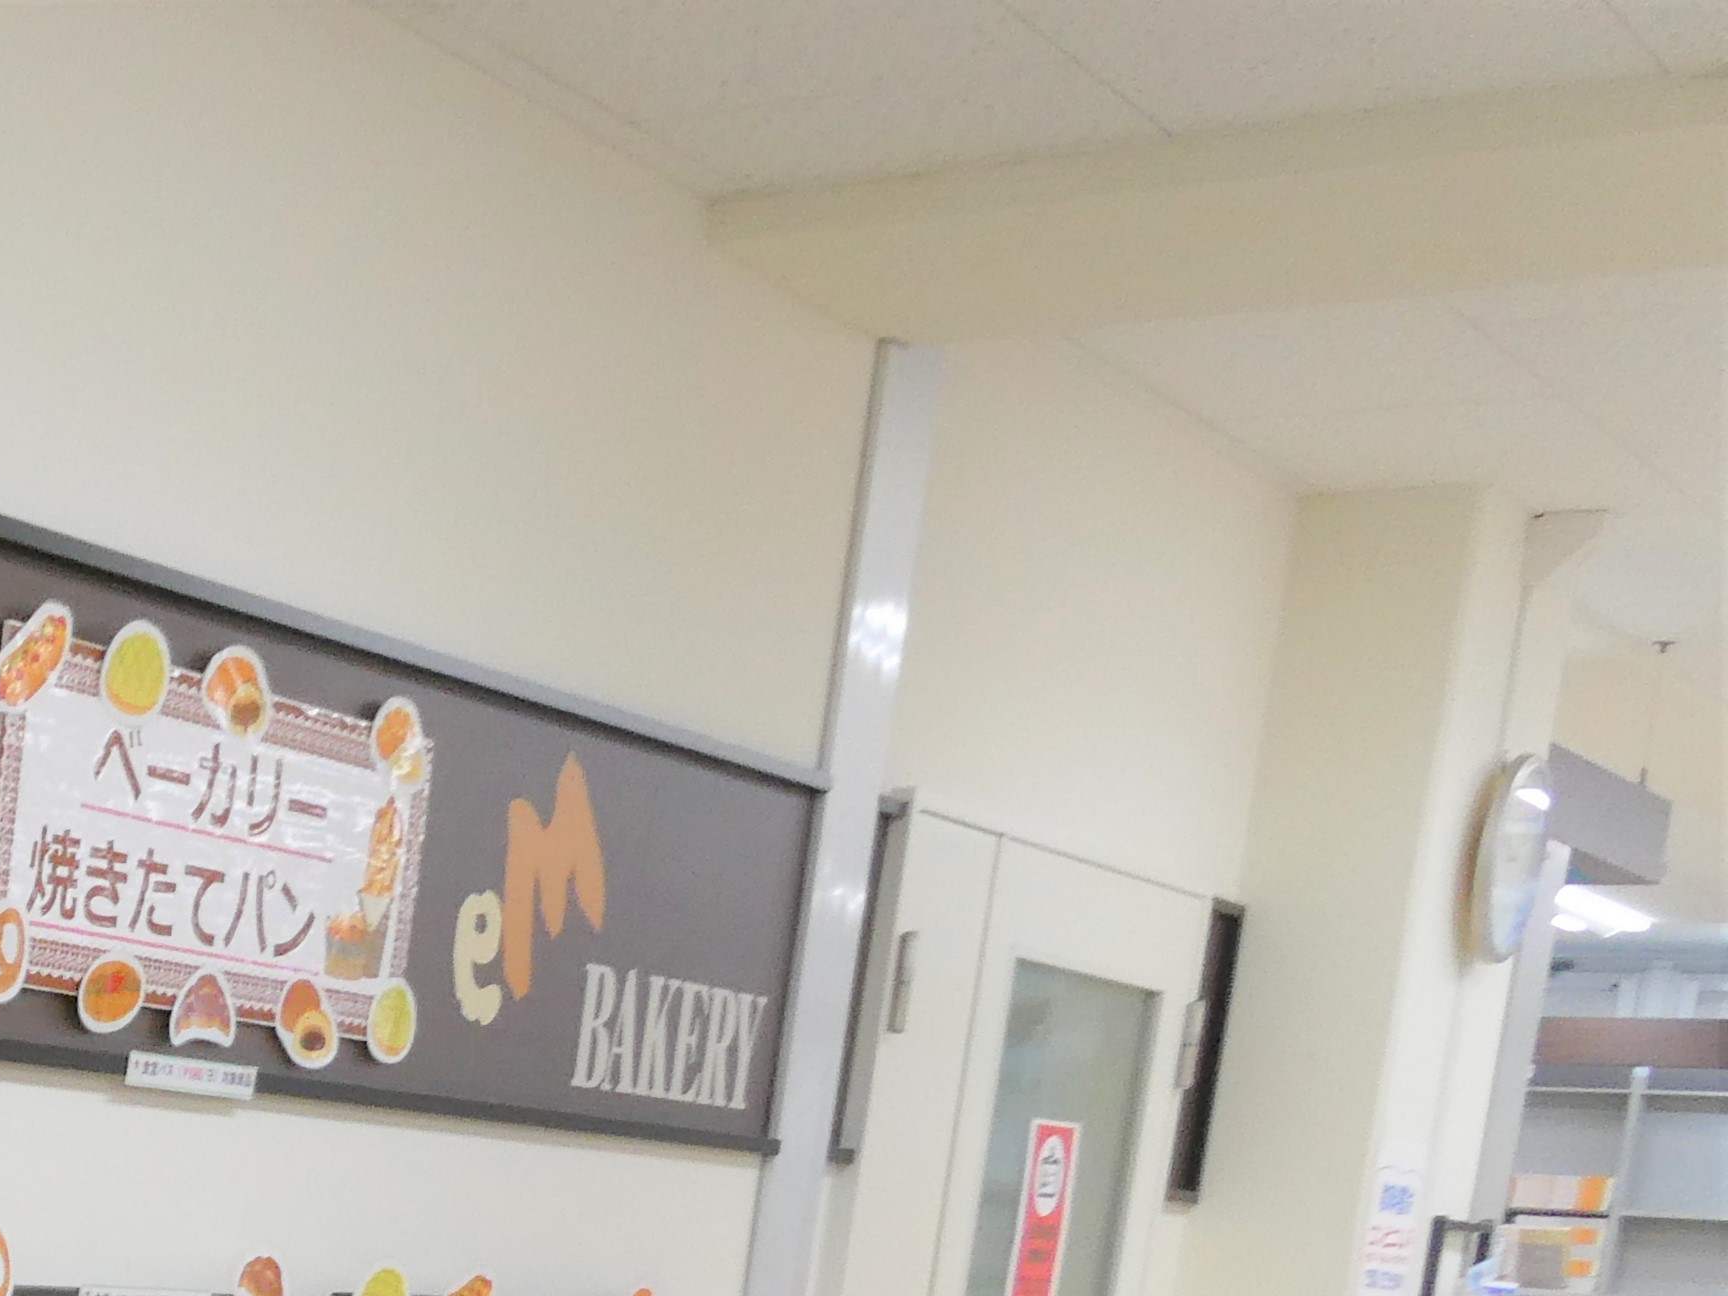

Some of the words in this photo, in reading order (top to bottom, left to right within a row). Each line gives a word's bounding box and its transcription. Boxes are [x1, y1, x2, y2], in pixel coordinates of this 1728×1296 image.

[92, 728, 329, 840] ベーカリー
[25, 824, 318, 960] 焼きたてパン
[571, 961, 770, 1111] BAKERY
